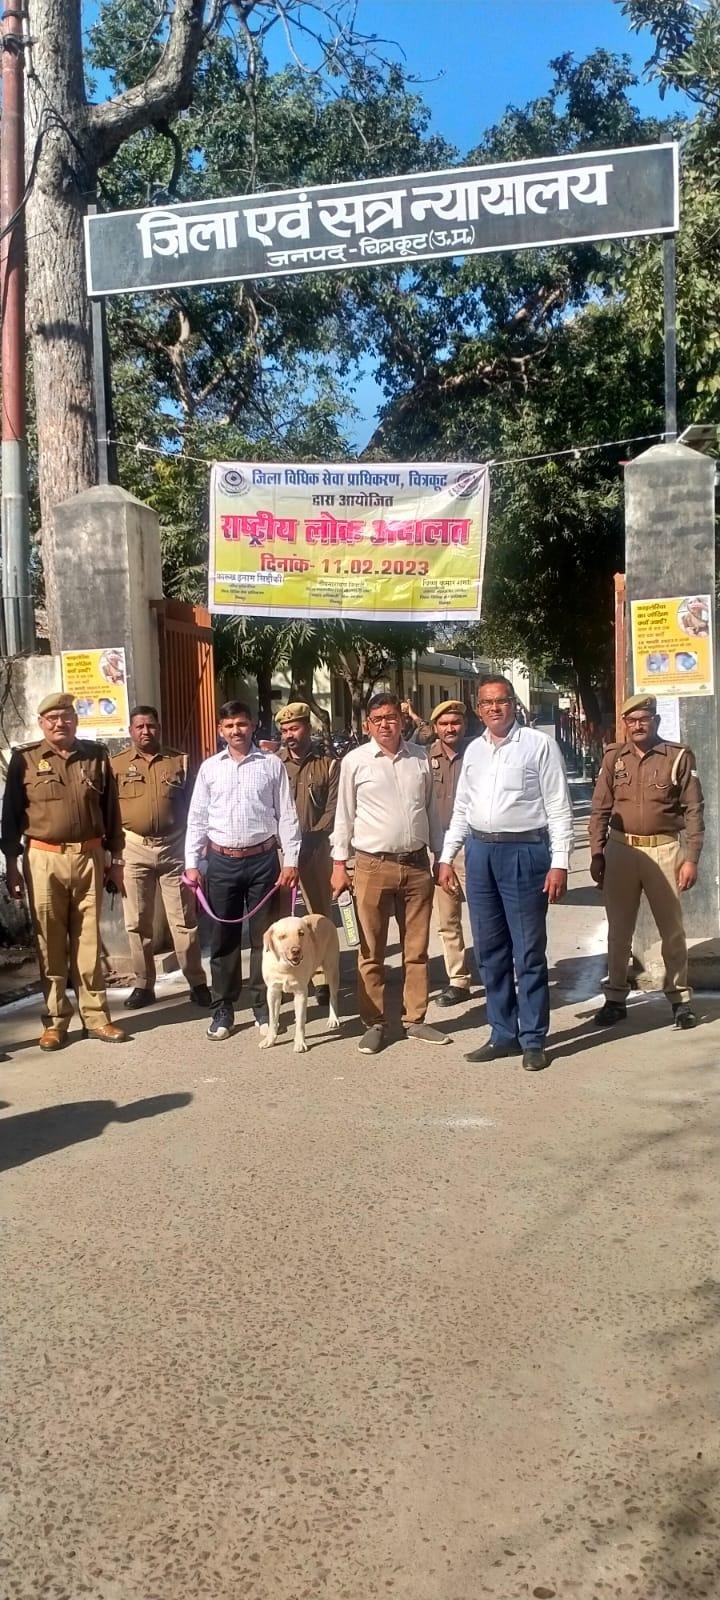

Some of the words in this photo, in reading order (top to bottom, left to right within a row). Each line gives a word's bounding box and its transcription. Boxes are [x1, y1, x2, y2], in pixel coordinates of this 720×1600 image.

[243, 193, 312, 246] एवं
[318, 189, 407, 237] सत्र
[410, 164, 614, 222] न्यायालय
[252, 469, 281, 485] जिला
[284, 469, 319, 486] विधिक
[321, 469, 344, 486] सेवा
[347, 470, 404, 489] प्राधिकरण,
[408, 470, 449, 492] चित्रकूट
[312, 494, 335, 507] द्वारा
[338, 491, 394, 507] आयोजित
[219, 510, 300, 547] राष्ट्रीय
[303, 511, 366, 545] लोक
[370, 518, 474, 546] अदालत
[321, 559, 430, 576] 11.02.2023
